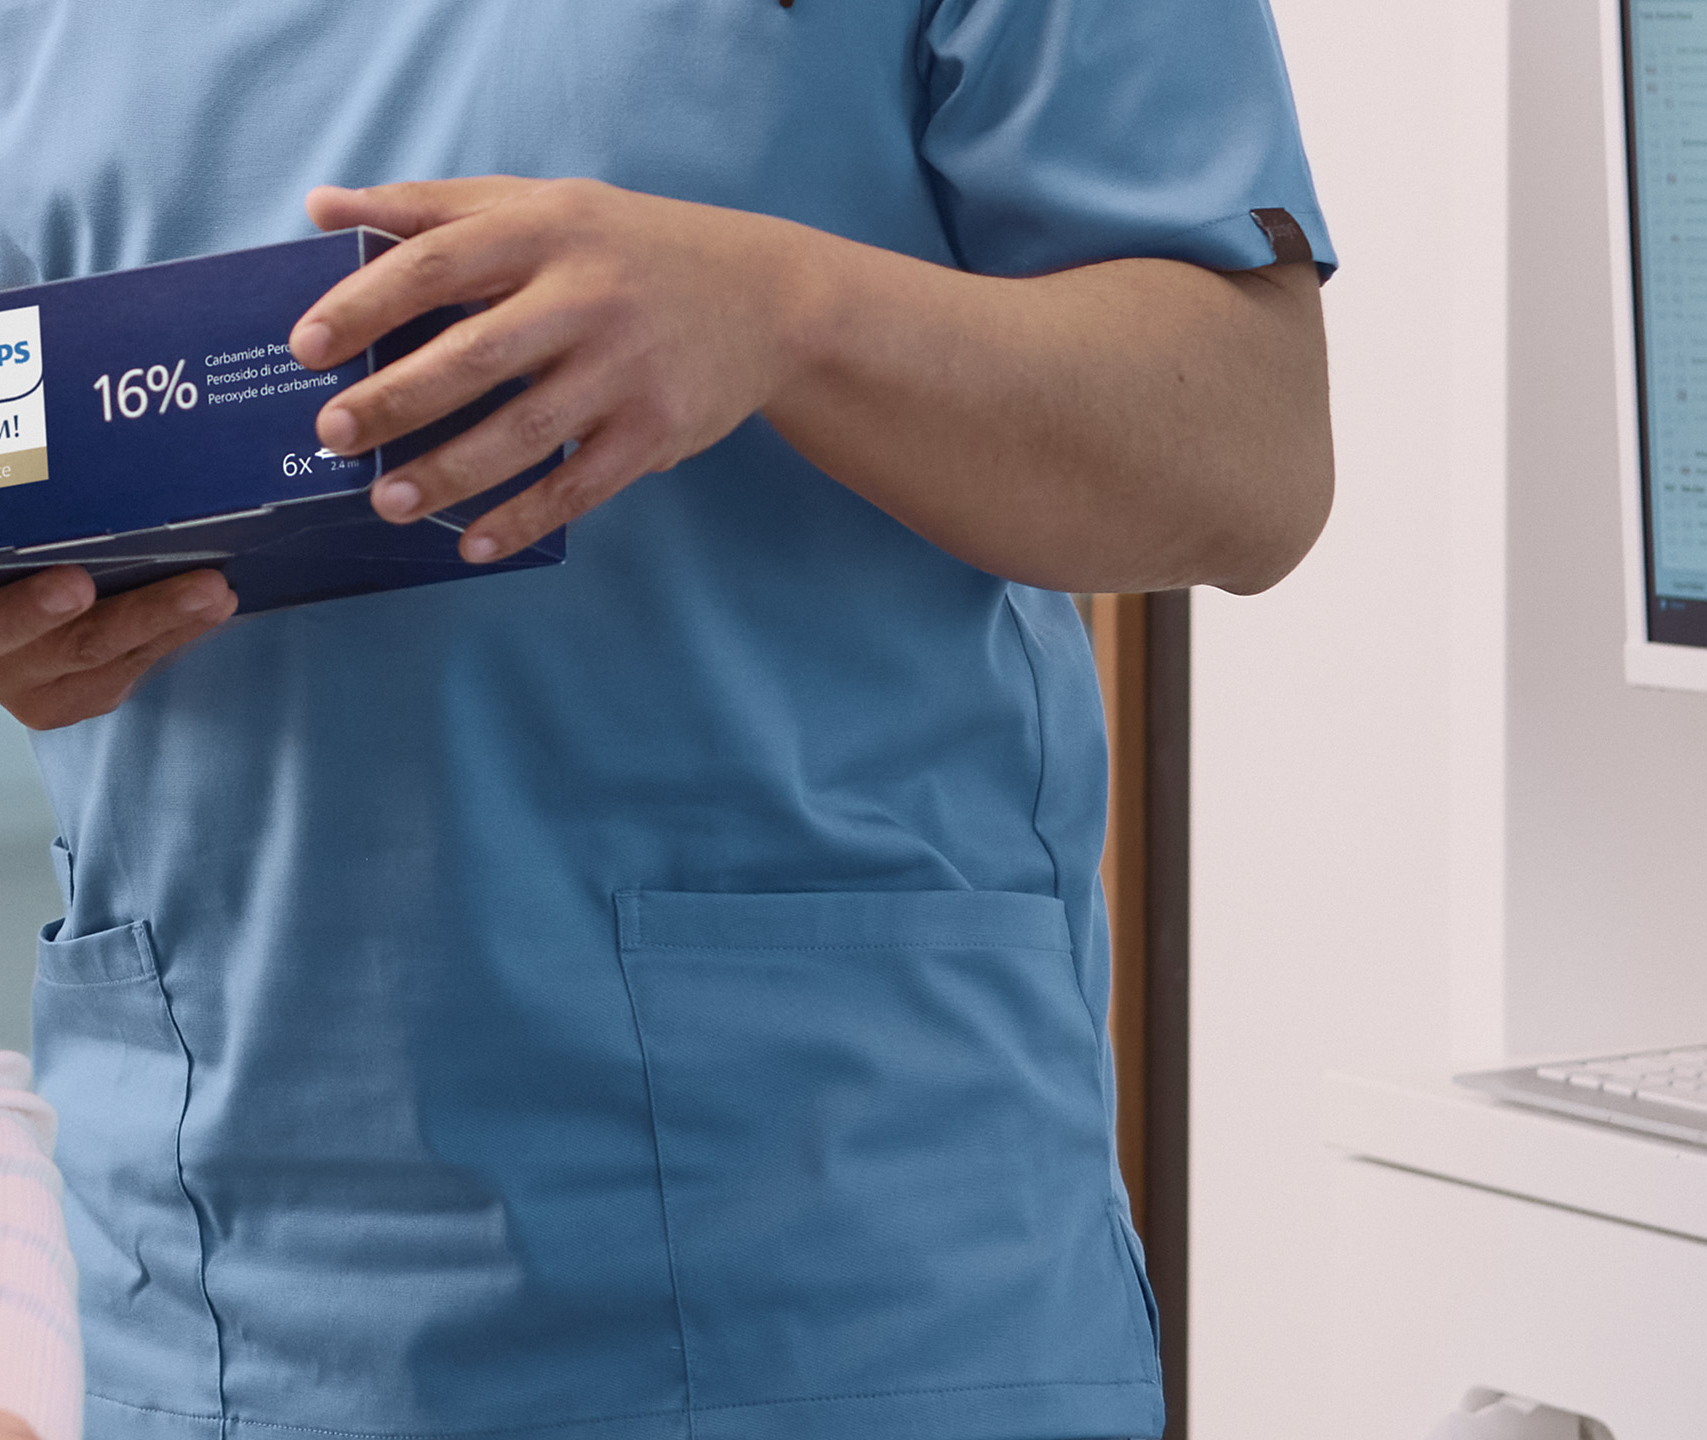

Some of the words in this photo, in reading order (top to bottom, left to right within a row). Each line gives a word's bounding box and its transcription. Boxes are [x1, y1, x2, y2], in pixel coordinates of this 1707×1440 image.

[204, 346, 266, 367] Carbamide
[267, 343, 291, 356] Pero
[206, 366, 259, 387] Perossido
[259, 363, 272, 377] di
[93, 358, 199, 422] 16%
[208, 386, 259, 405] Peroxyde
[259, 383, 276, 397] de
[277, 372, 339, 394] carbamide
[282, 452, 313, 477] 6x
